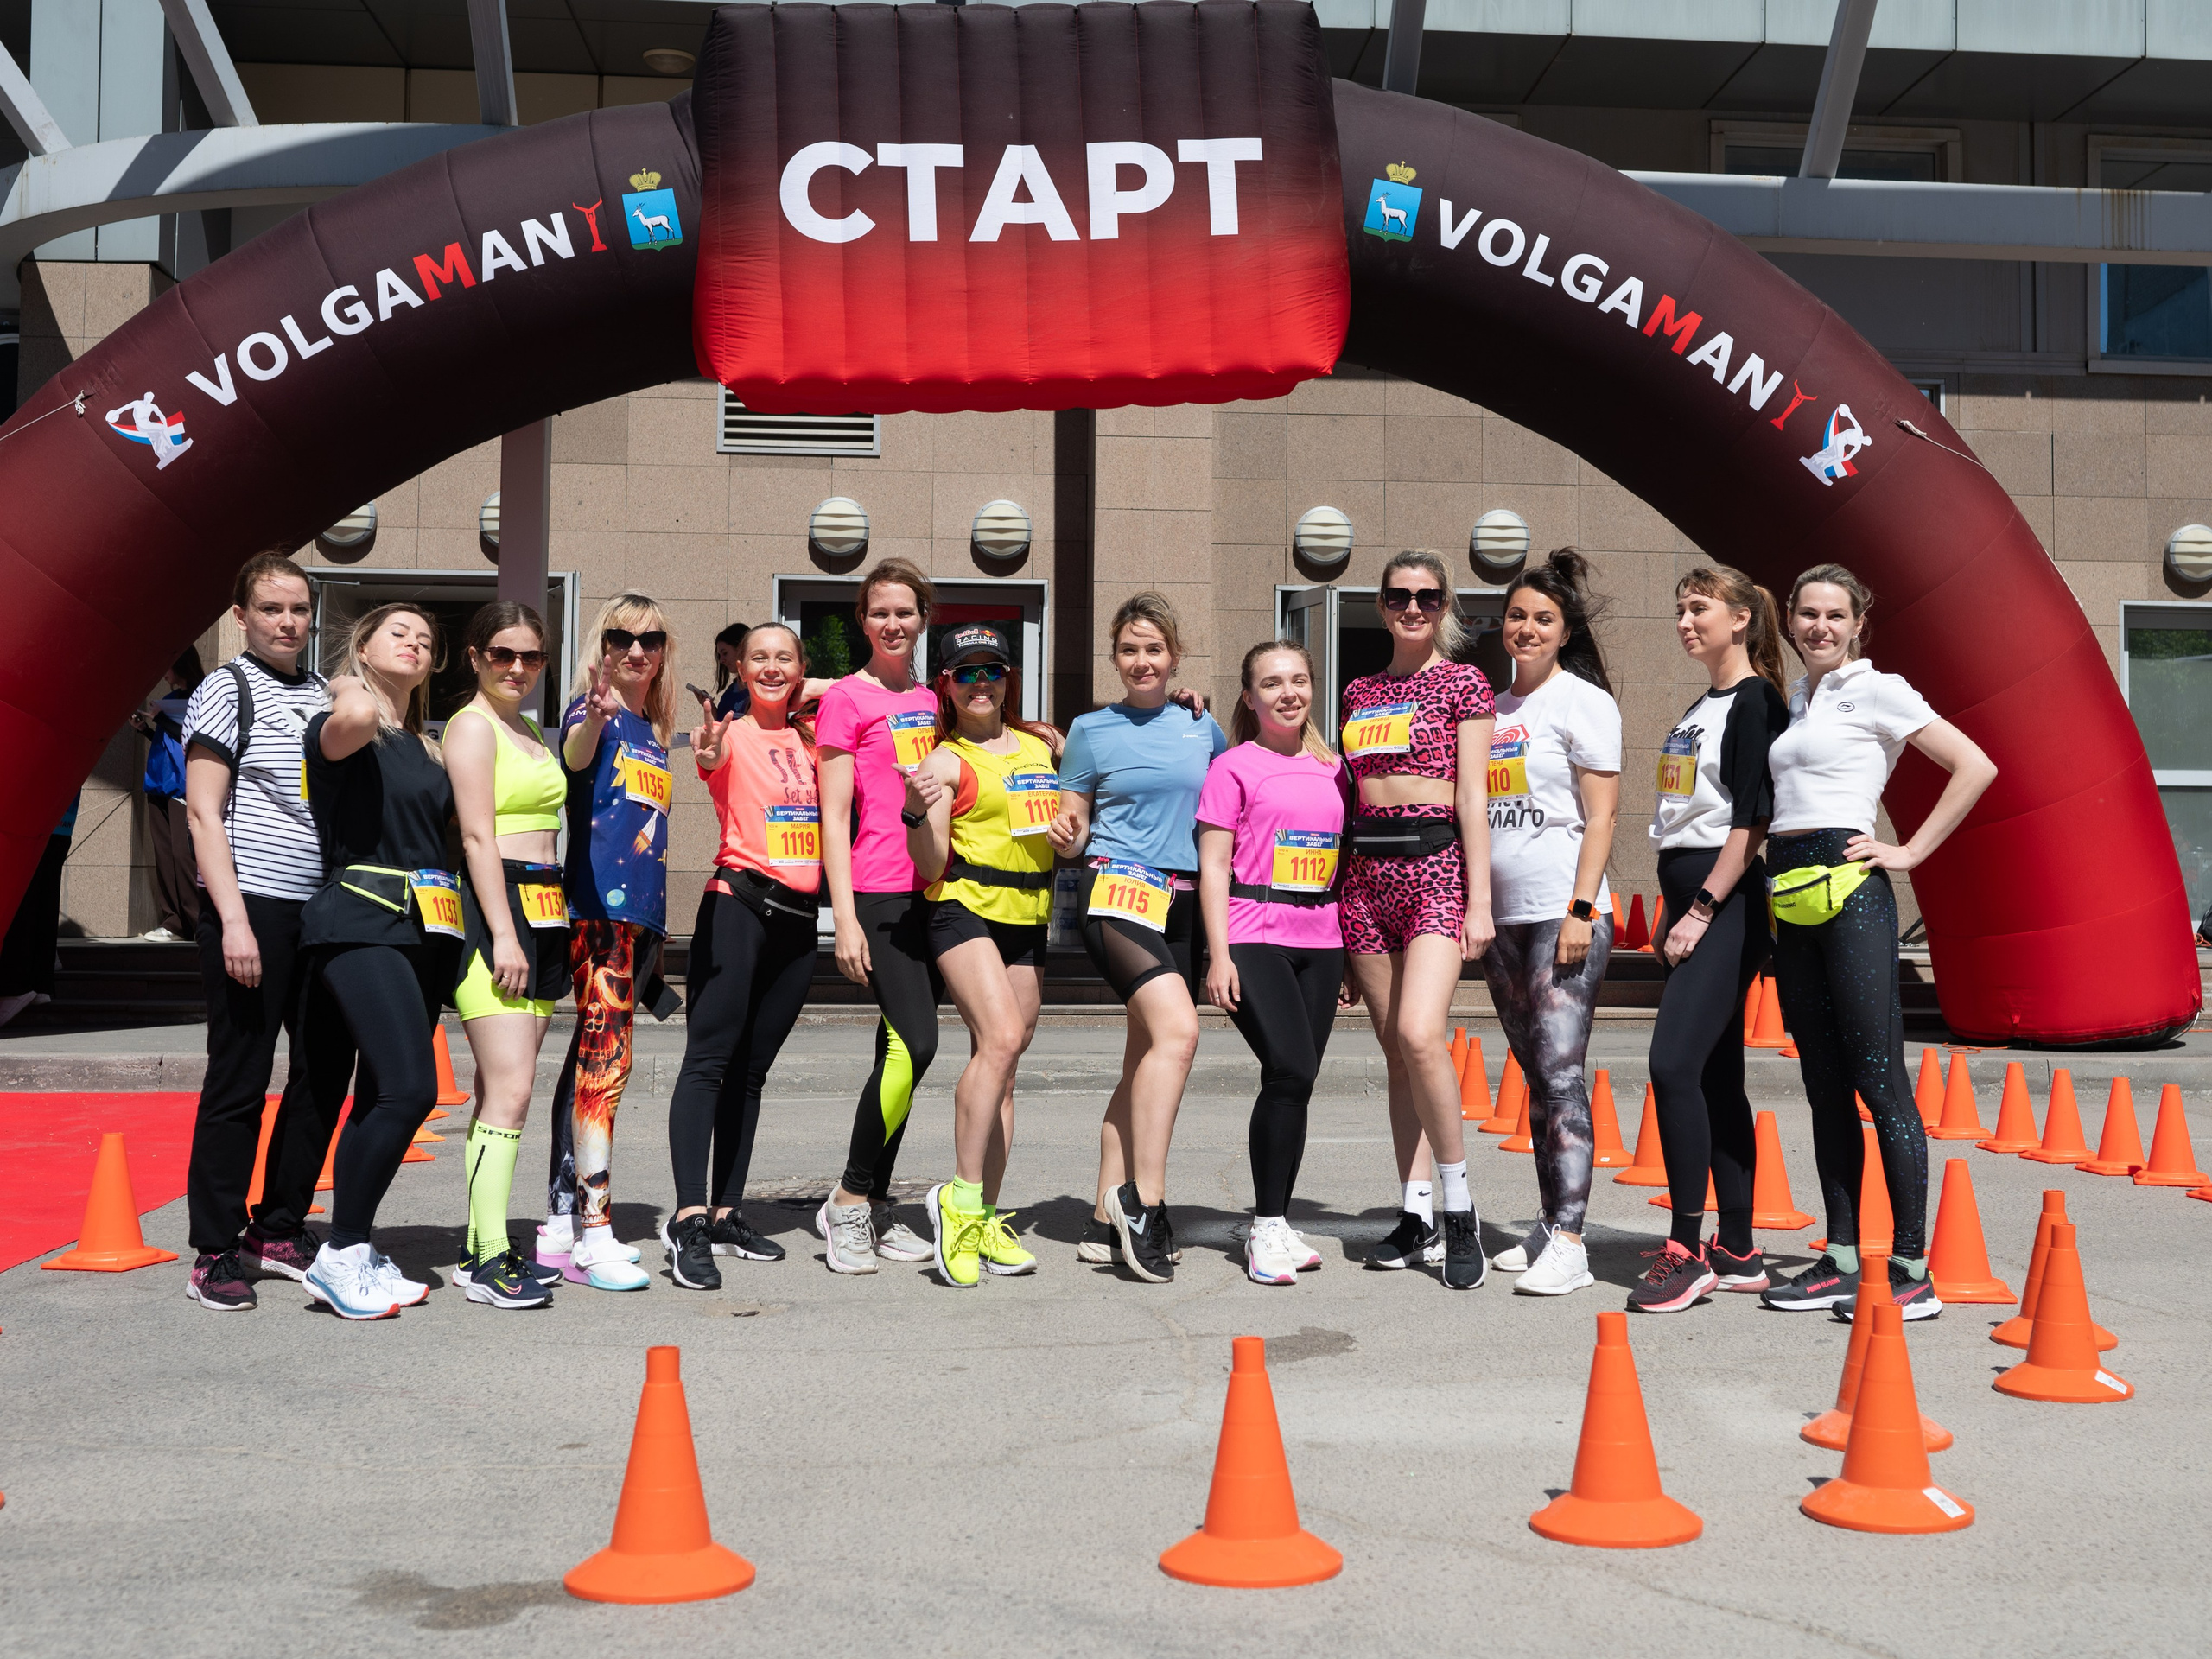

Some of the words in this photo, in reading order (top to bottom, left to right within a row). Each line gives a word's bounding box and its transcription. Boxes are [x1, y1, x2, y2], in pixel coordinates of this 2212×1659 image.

[779, 137, 1263, 244] СТАРТ
[956, 635, 998, 644] RACING
[912, 734, 937, 760] 111
[1358, 722, 1392, 747] 1111
[637, 769, 664, 801] 1135
[1661, 764, 1681, 790] 1131
[1024, 798, 1058, 823] 1116
[781, 831, 815, 855] 1119
[1111, 864, 1163, 883] ВЕРТИКАЛЬНЫЙ
[1127, 870, 1147, 881] ЗАБЕГ
[1291, 856, 1326, 881] 1112
[1124, 877, 1146, 888] ЮЛИЯ
[432, 896, 458, 925] 1133
[536, 891, 565, 917] 1132
[1108, 883, 1150, 914] 1115
